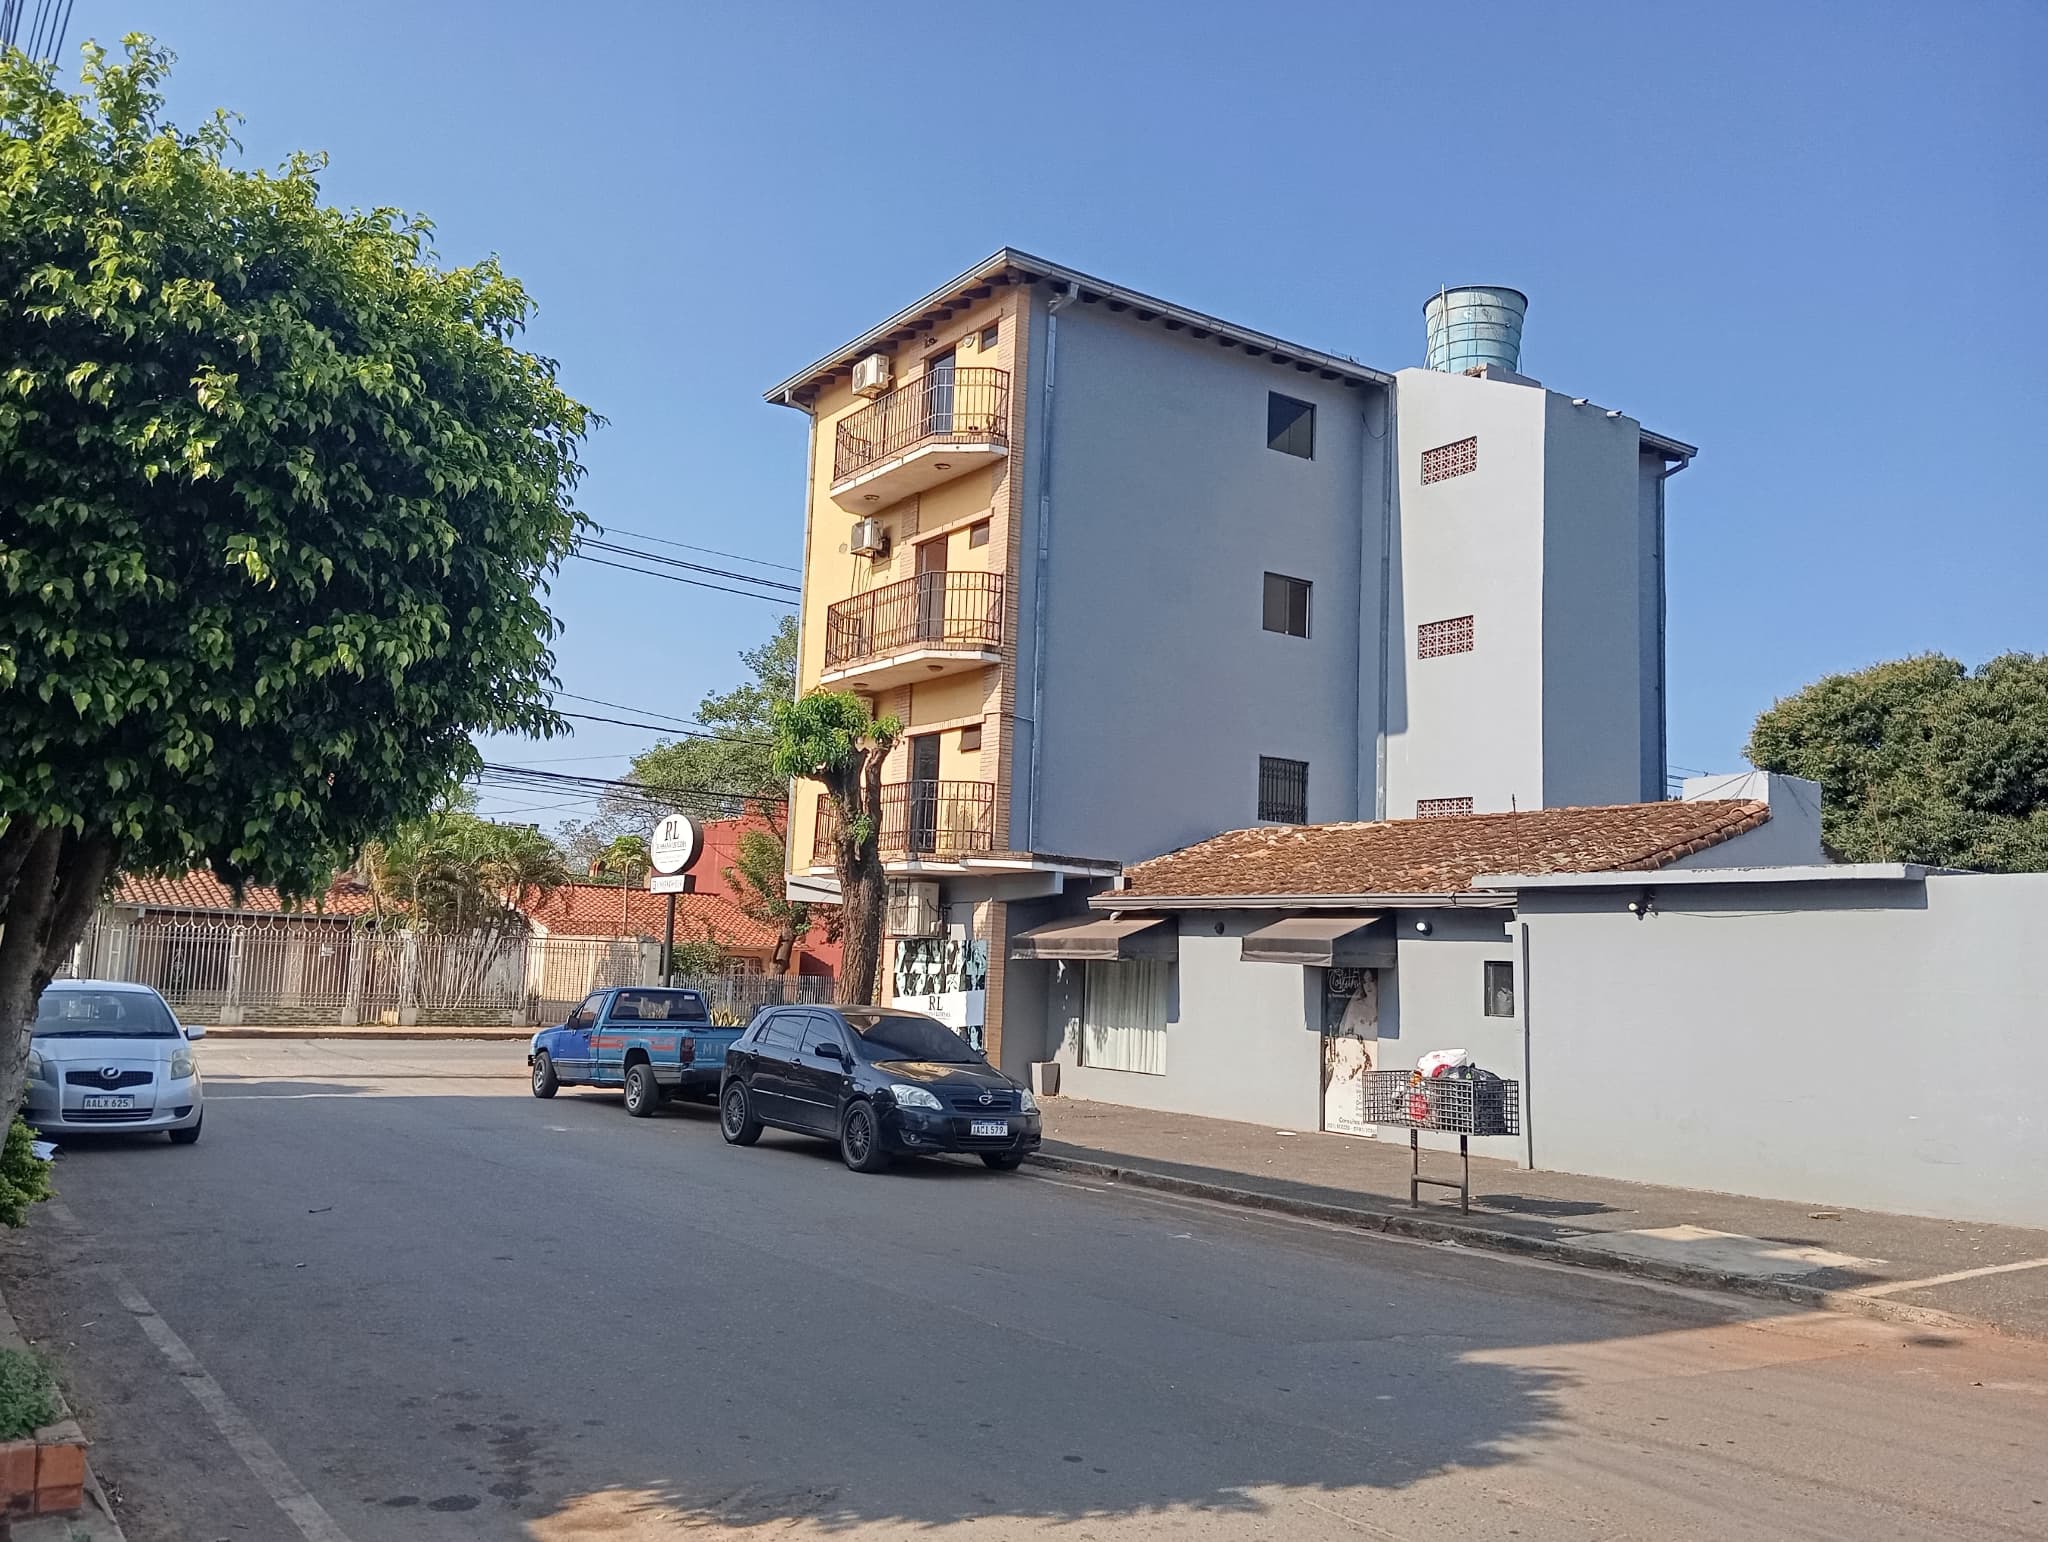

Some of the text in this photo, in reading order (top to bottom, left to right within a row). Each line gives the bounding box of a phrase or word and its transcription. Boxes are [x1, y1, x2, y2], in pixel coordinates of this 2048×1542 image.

[664, 820, 680, 842] RL
[928, 995, 944, 1011] RL
[111, 1099, 129, 1108] 625
[990, 1125, 1004, 1135] 579
